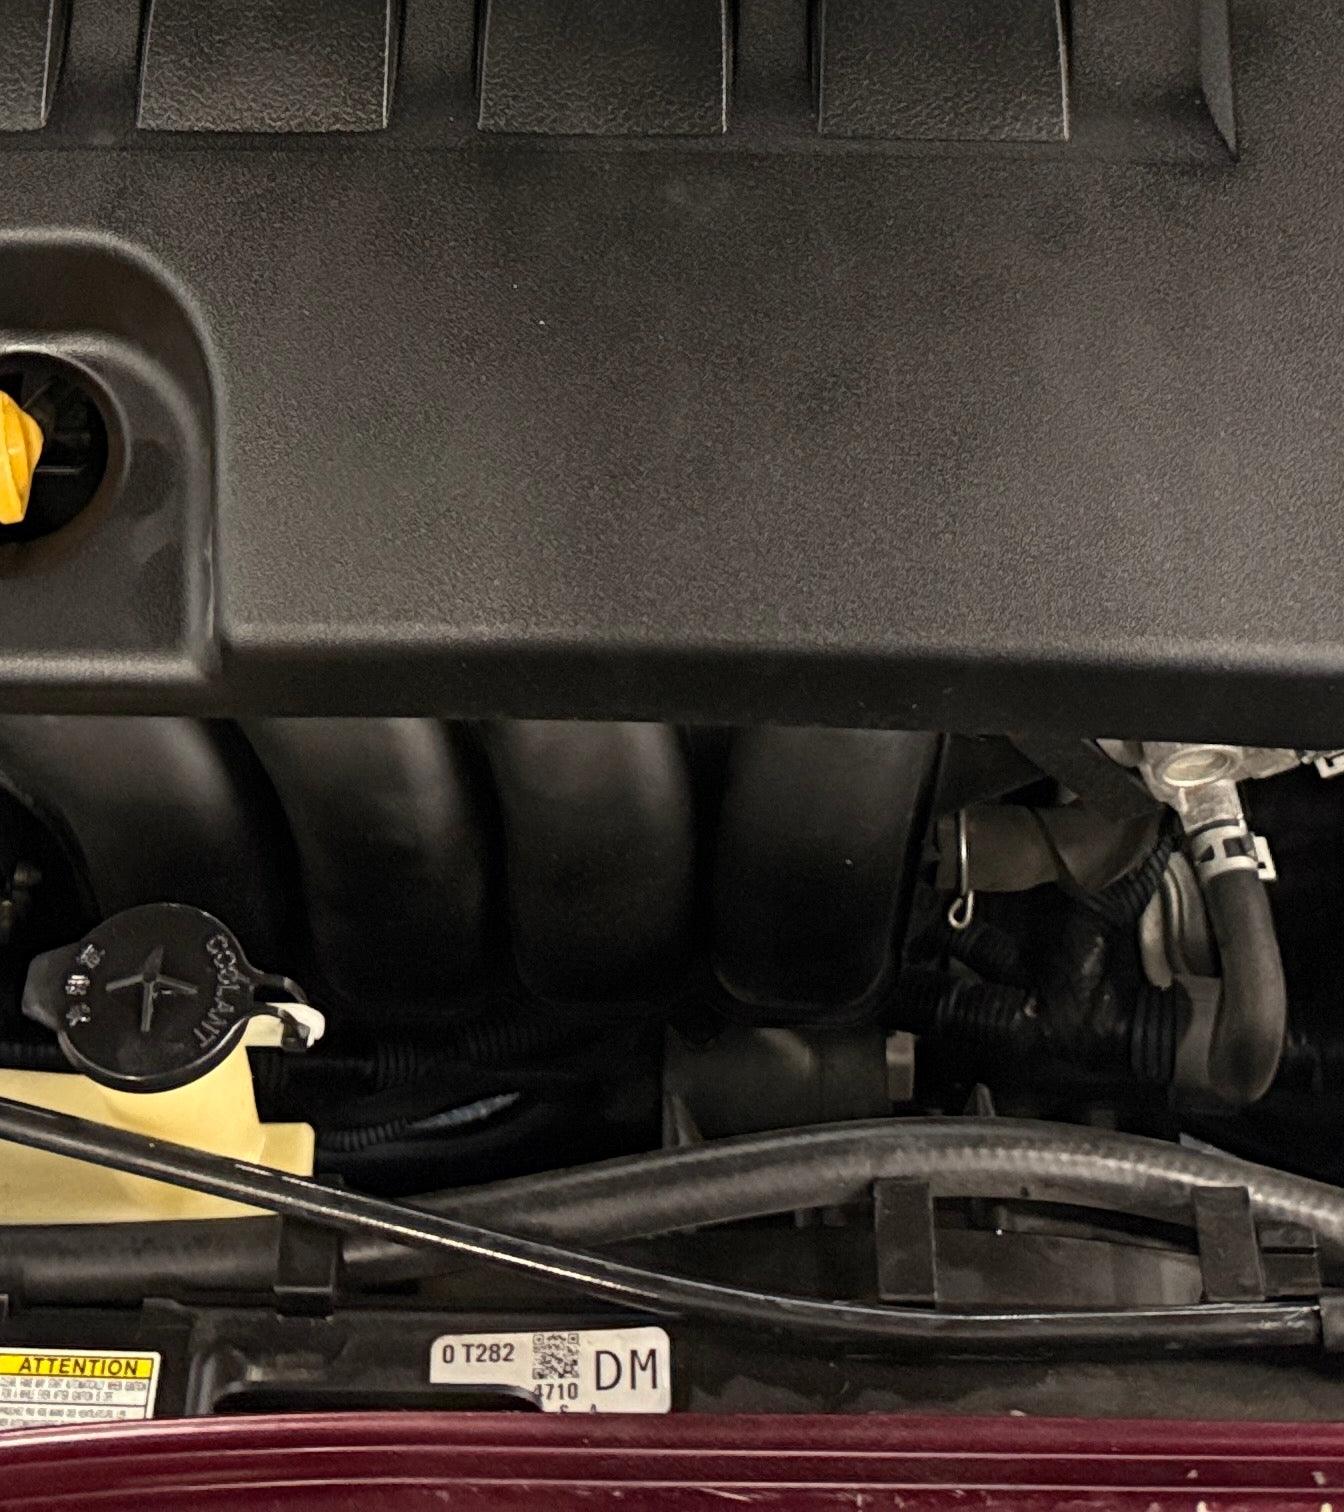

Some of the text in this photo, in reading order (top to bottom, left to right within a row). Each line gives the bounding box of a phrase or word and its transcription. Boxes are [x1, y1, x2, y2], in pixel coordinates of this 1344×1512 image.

[193, 934, 242, 1048] COOLANT
[18, 1356, 140, 1377] ATTENTION
[461, 1343, 516, 1364] T282
[595, 1348, 657, 1391] DM
